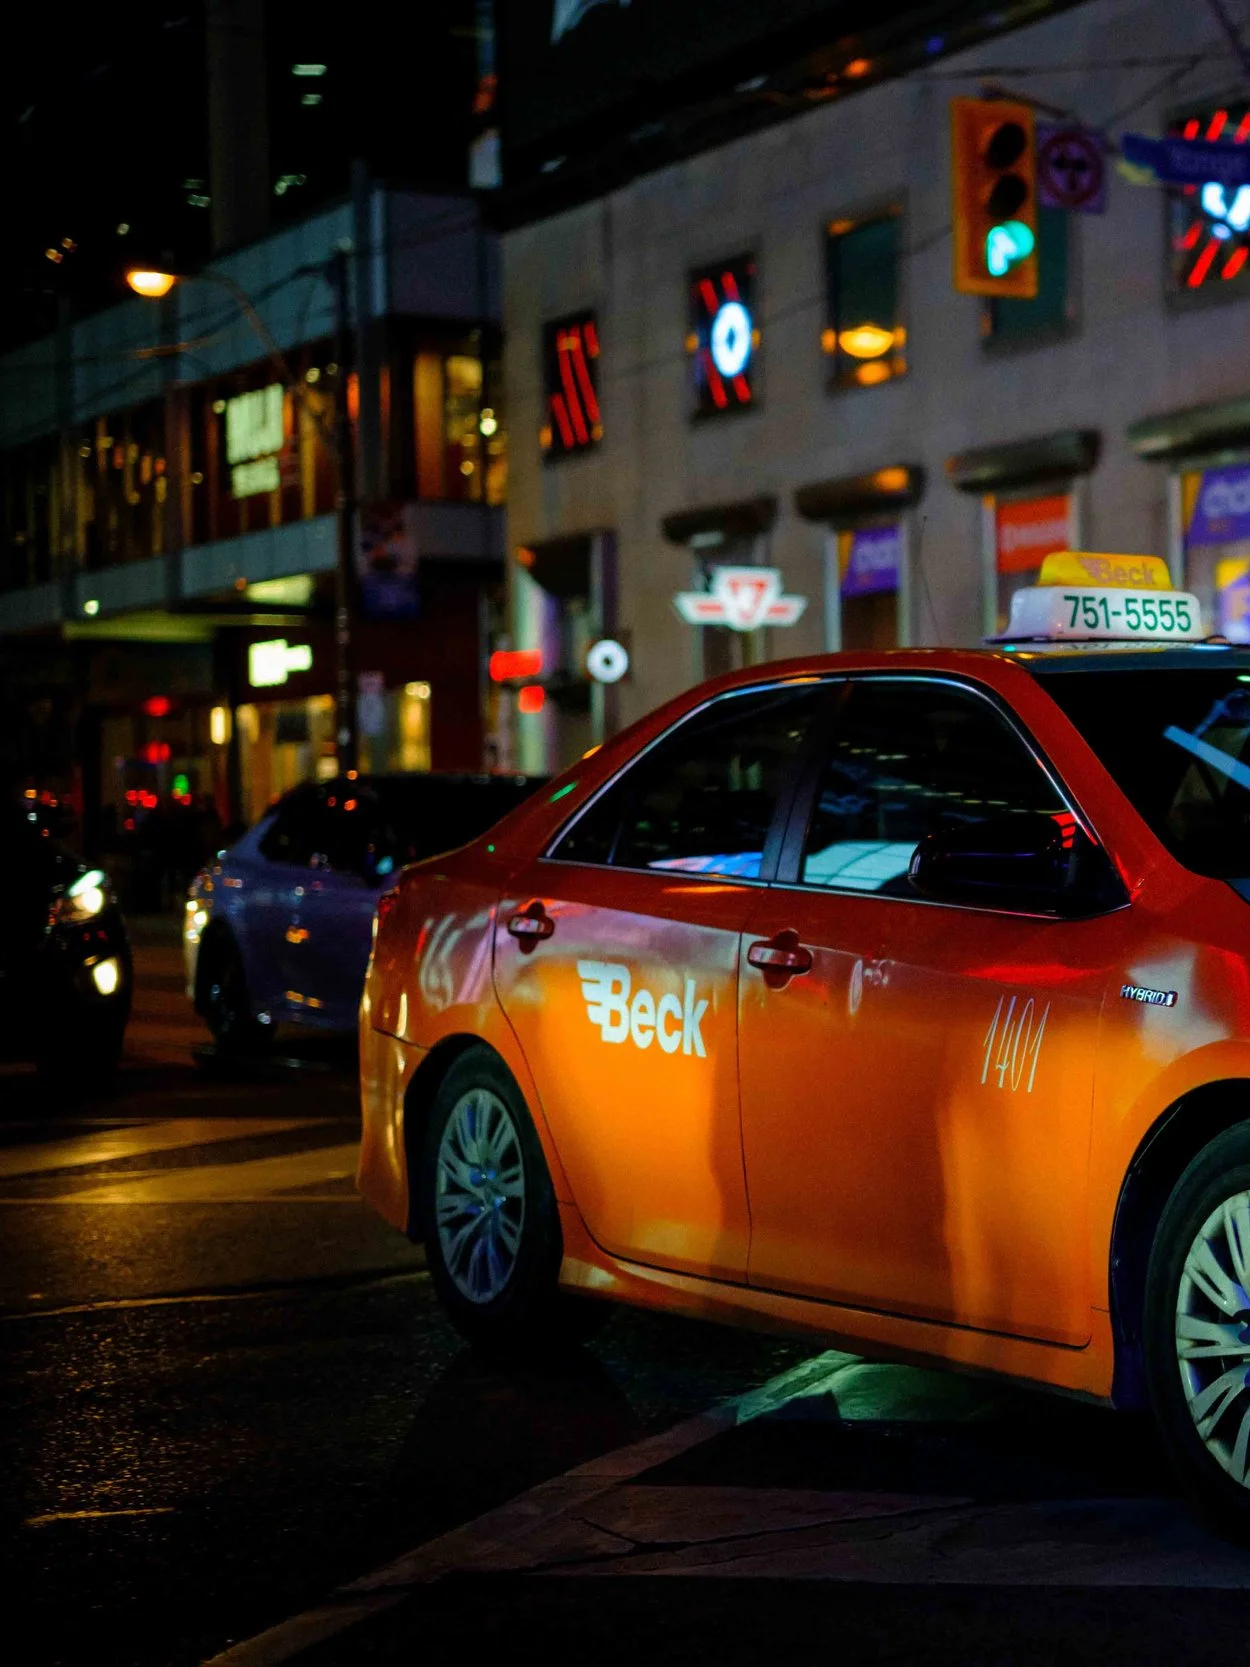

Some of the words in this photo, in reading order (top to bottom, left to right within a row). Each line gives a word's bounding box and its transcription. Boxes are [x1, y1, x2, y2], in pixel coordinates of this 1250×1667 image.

[1079, 558, 1156, 586] Beck
[1064, 595, 1192, 632] 751-5555
[577, 959, 709, 1058] Beck
[1120, 984, 1166, 1004] HYBRID
[976, 995, 1050, 1093] 1401
